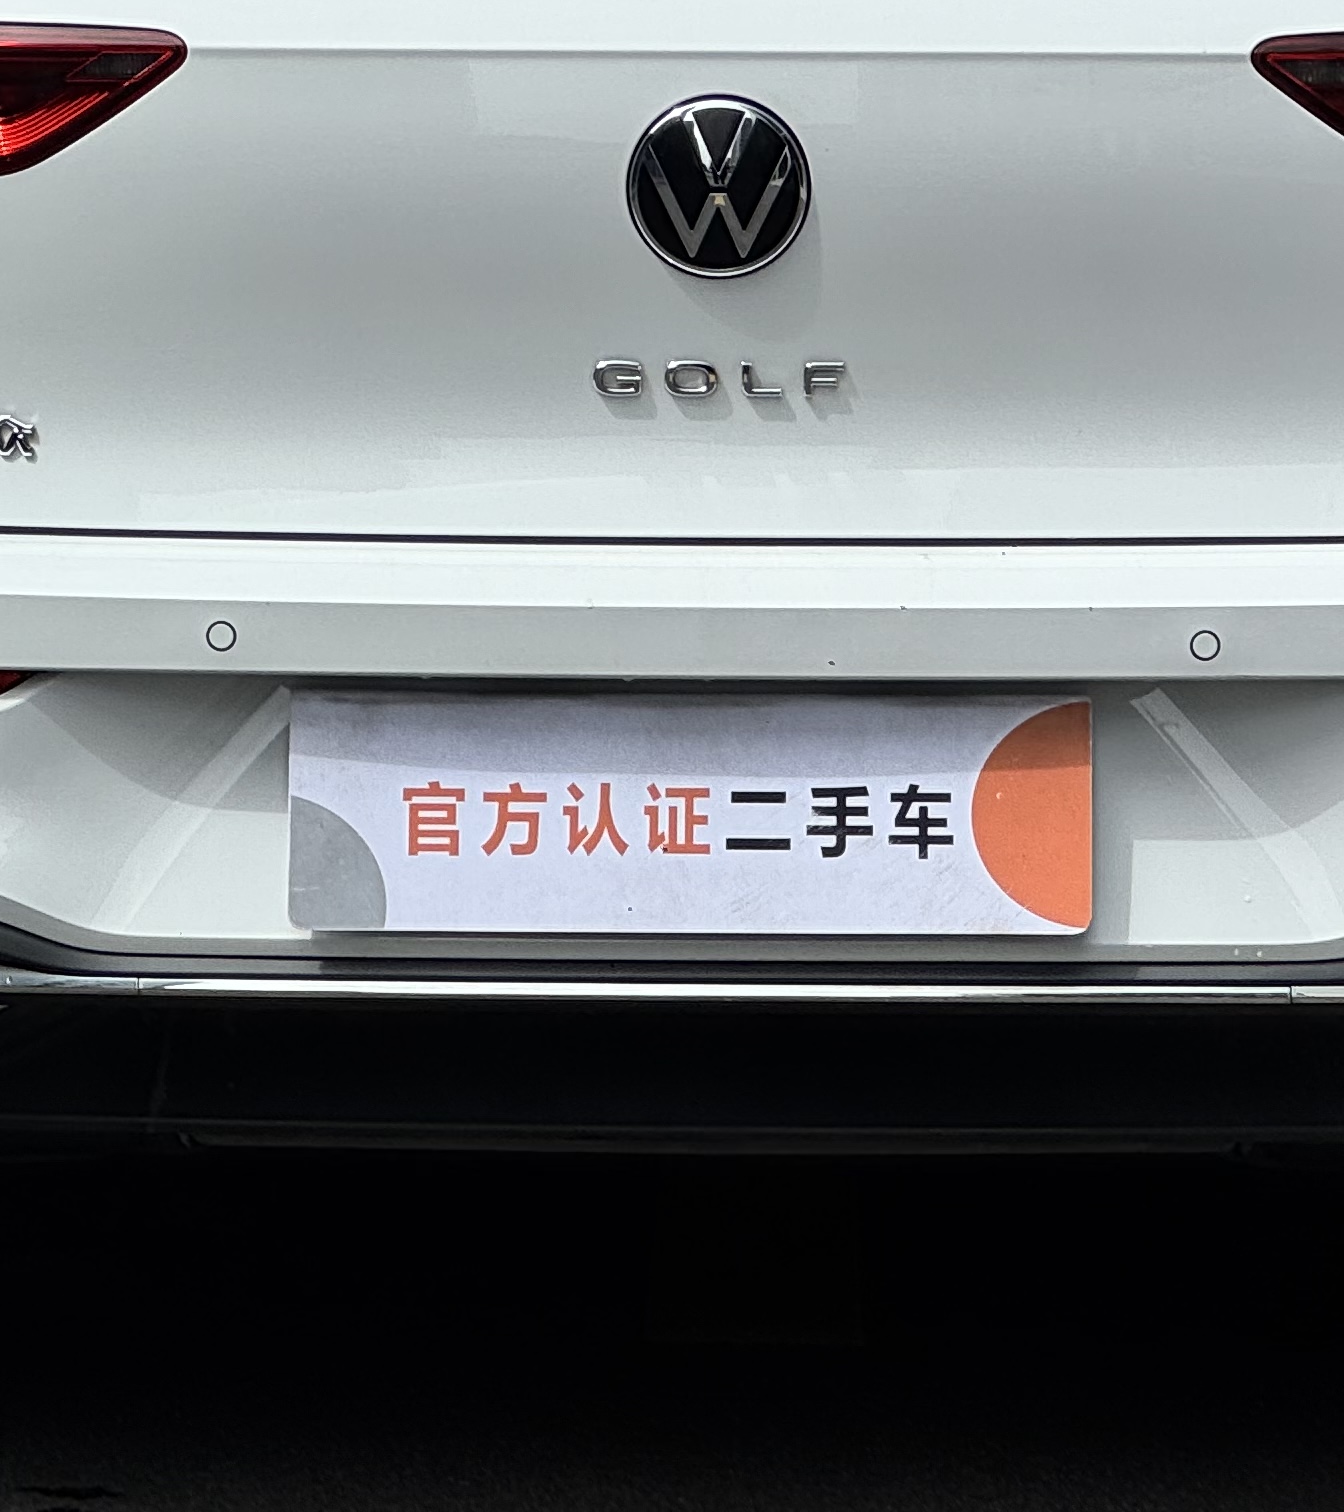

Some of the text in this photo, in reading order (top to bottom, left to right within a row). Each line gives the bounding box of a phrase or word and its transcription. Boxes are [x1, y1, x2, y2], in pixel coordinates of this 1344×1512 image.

[593, 359, 845, 397] GOLF
[401, 781, 955, 860] 官方认证二手车
